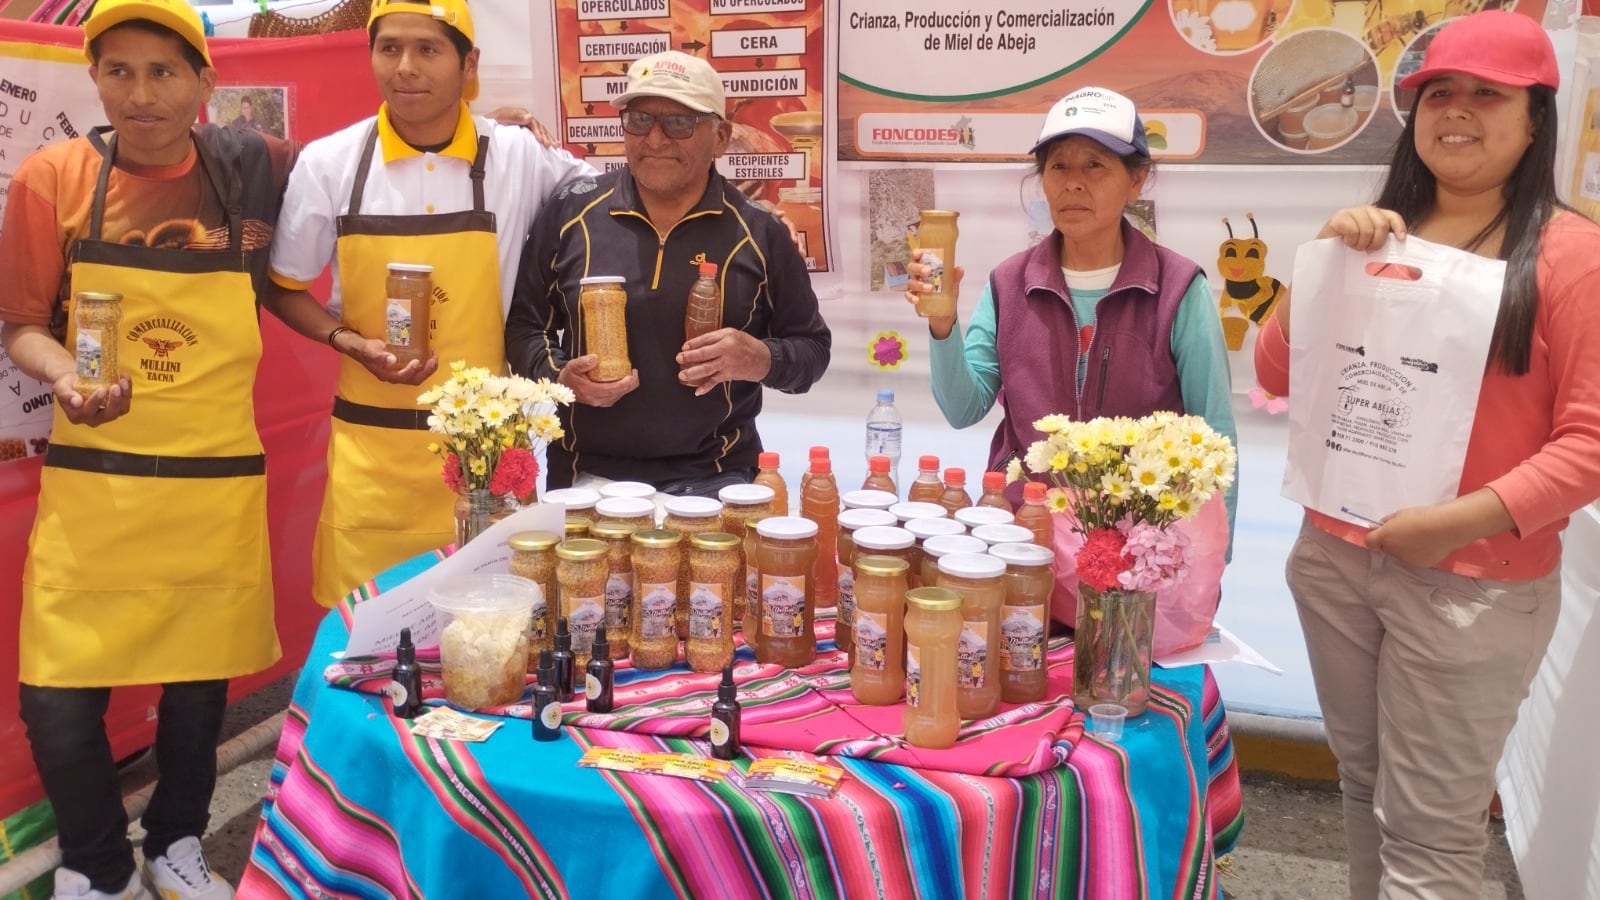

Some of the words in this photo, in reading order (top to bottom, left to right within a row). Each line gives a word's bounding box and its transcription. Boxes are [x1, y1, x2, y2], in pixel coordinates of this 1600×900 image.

[582, 0, 665, 13] OPERCULADOS
[850, 11, 900, 31] Crianza,
[905, 9, 981, 28] Producción
[985, 14, 992, 32] y
[997, 7, 1115, 28] Comercialización
[585, 38, 667, 56] CERTIFUGACIÓN
[740, 36, 778, 49] CERA
[924, 33, 940, 50] de
[945, 33, 972, 51] Miel
[977, 33, 993, 50] de
[997, 33, 1036, 54] Abeja
[0, 79, 37, 102] ENERO
[722, 75, 798, 92] FUNDICIÓN
[872, 128, 958, 141] FONCODES
[729, 155, 790, 166] RECIPIENTES
[735, 165, 784, 178] ESTÉRILES
[140, 358, 181, 373] MULLINI
[147, 372, 175, 383] TACNA
[1345, 395, 1371, 408] SUPER
[1371, 401, 1401, 416] ABEJAS
